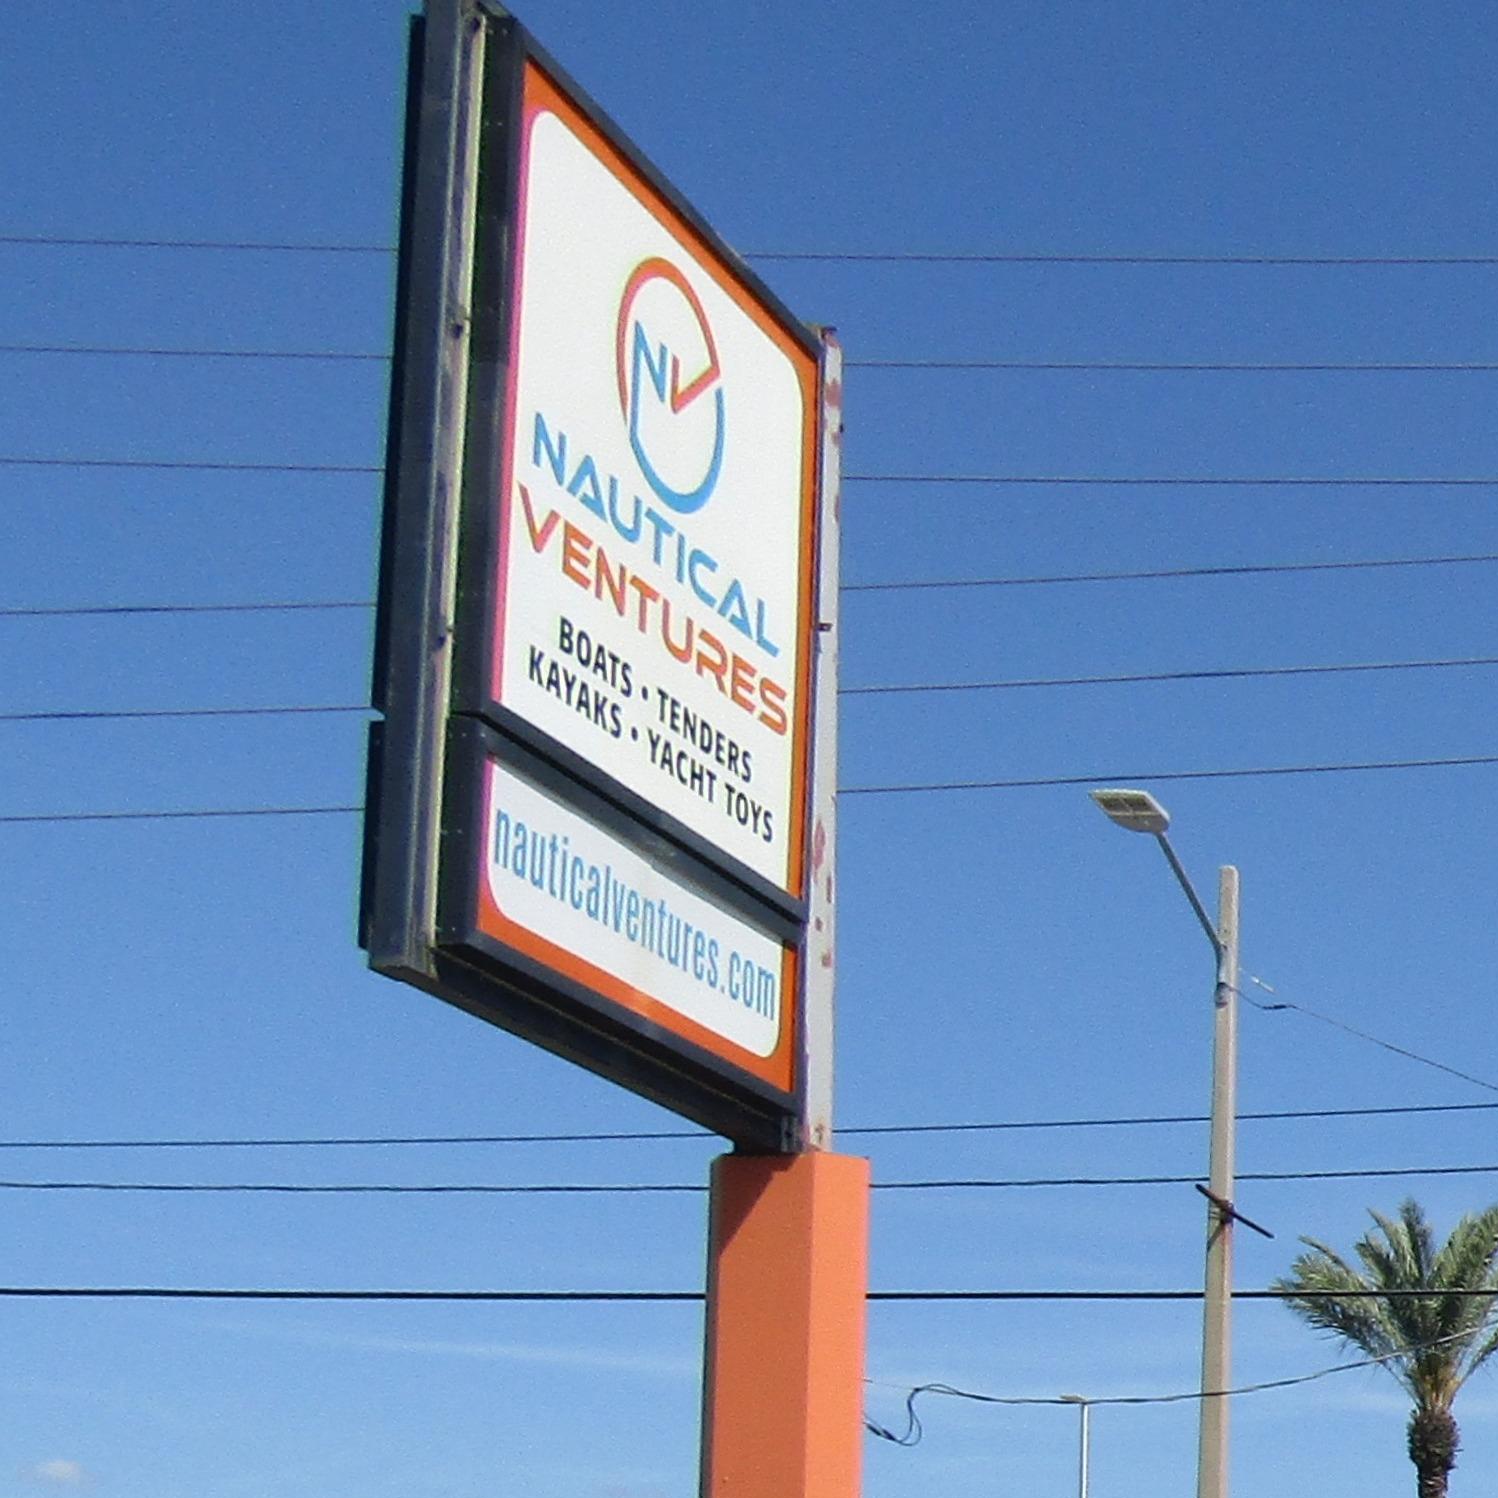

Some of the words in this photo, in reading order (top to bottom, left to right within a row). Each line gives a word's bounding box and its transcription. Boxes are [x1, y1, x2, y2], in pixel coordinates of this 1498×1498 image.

[518, 480, 788, 736] VENTURES
[532, 412, 779, 657] NAUTICAL
[529, 645, 622, 739] KAYAKS
[647, 727, 717, 803] YACHT
[724, 782, 773, 843] TOYS
[559, 615, 632, 698] BOATS
[656, 687, 752, 783] TENDERS
[493, 808, 776, 1021] nauticalventures.com
